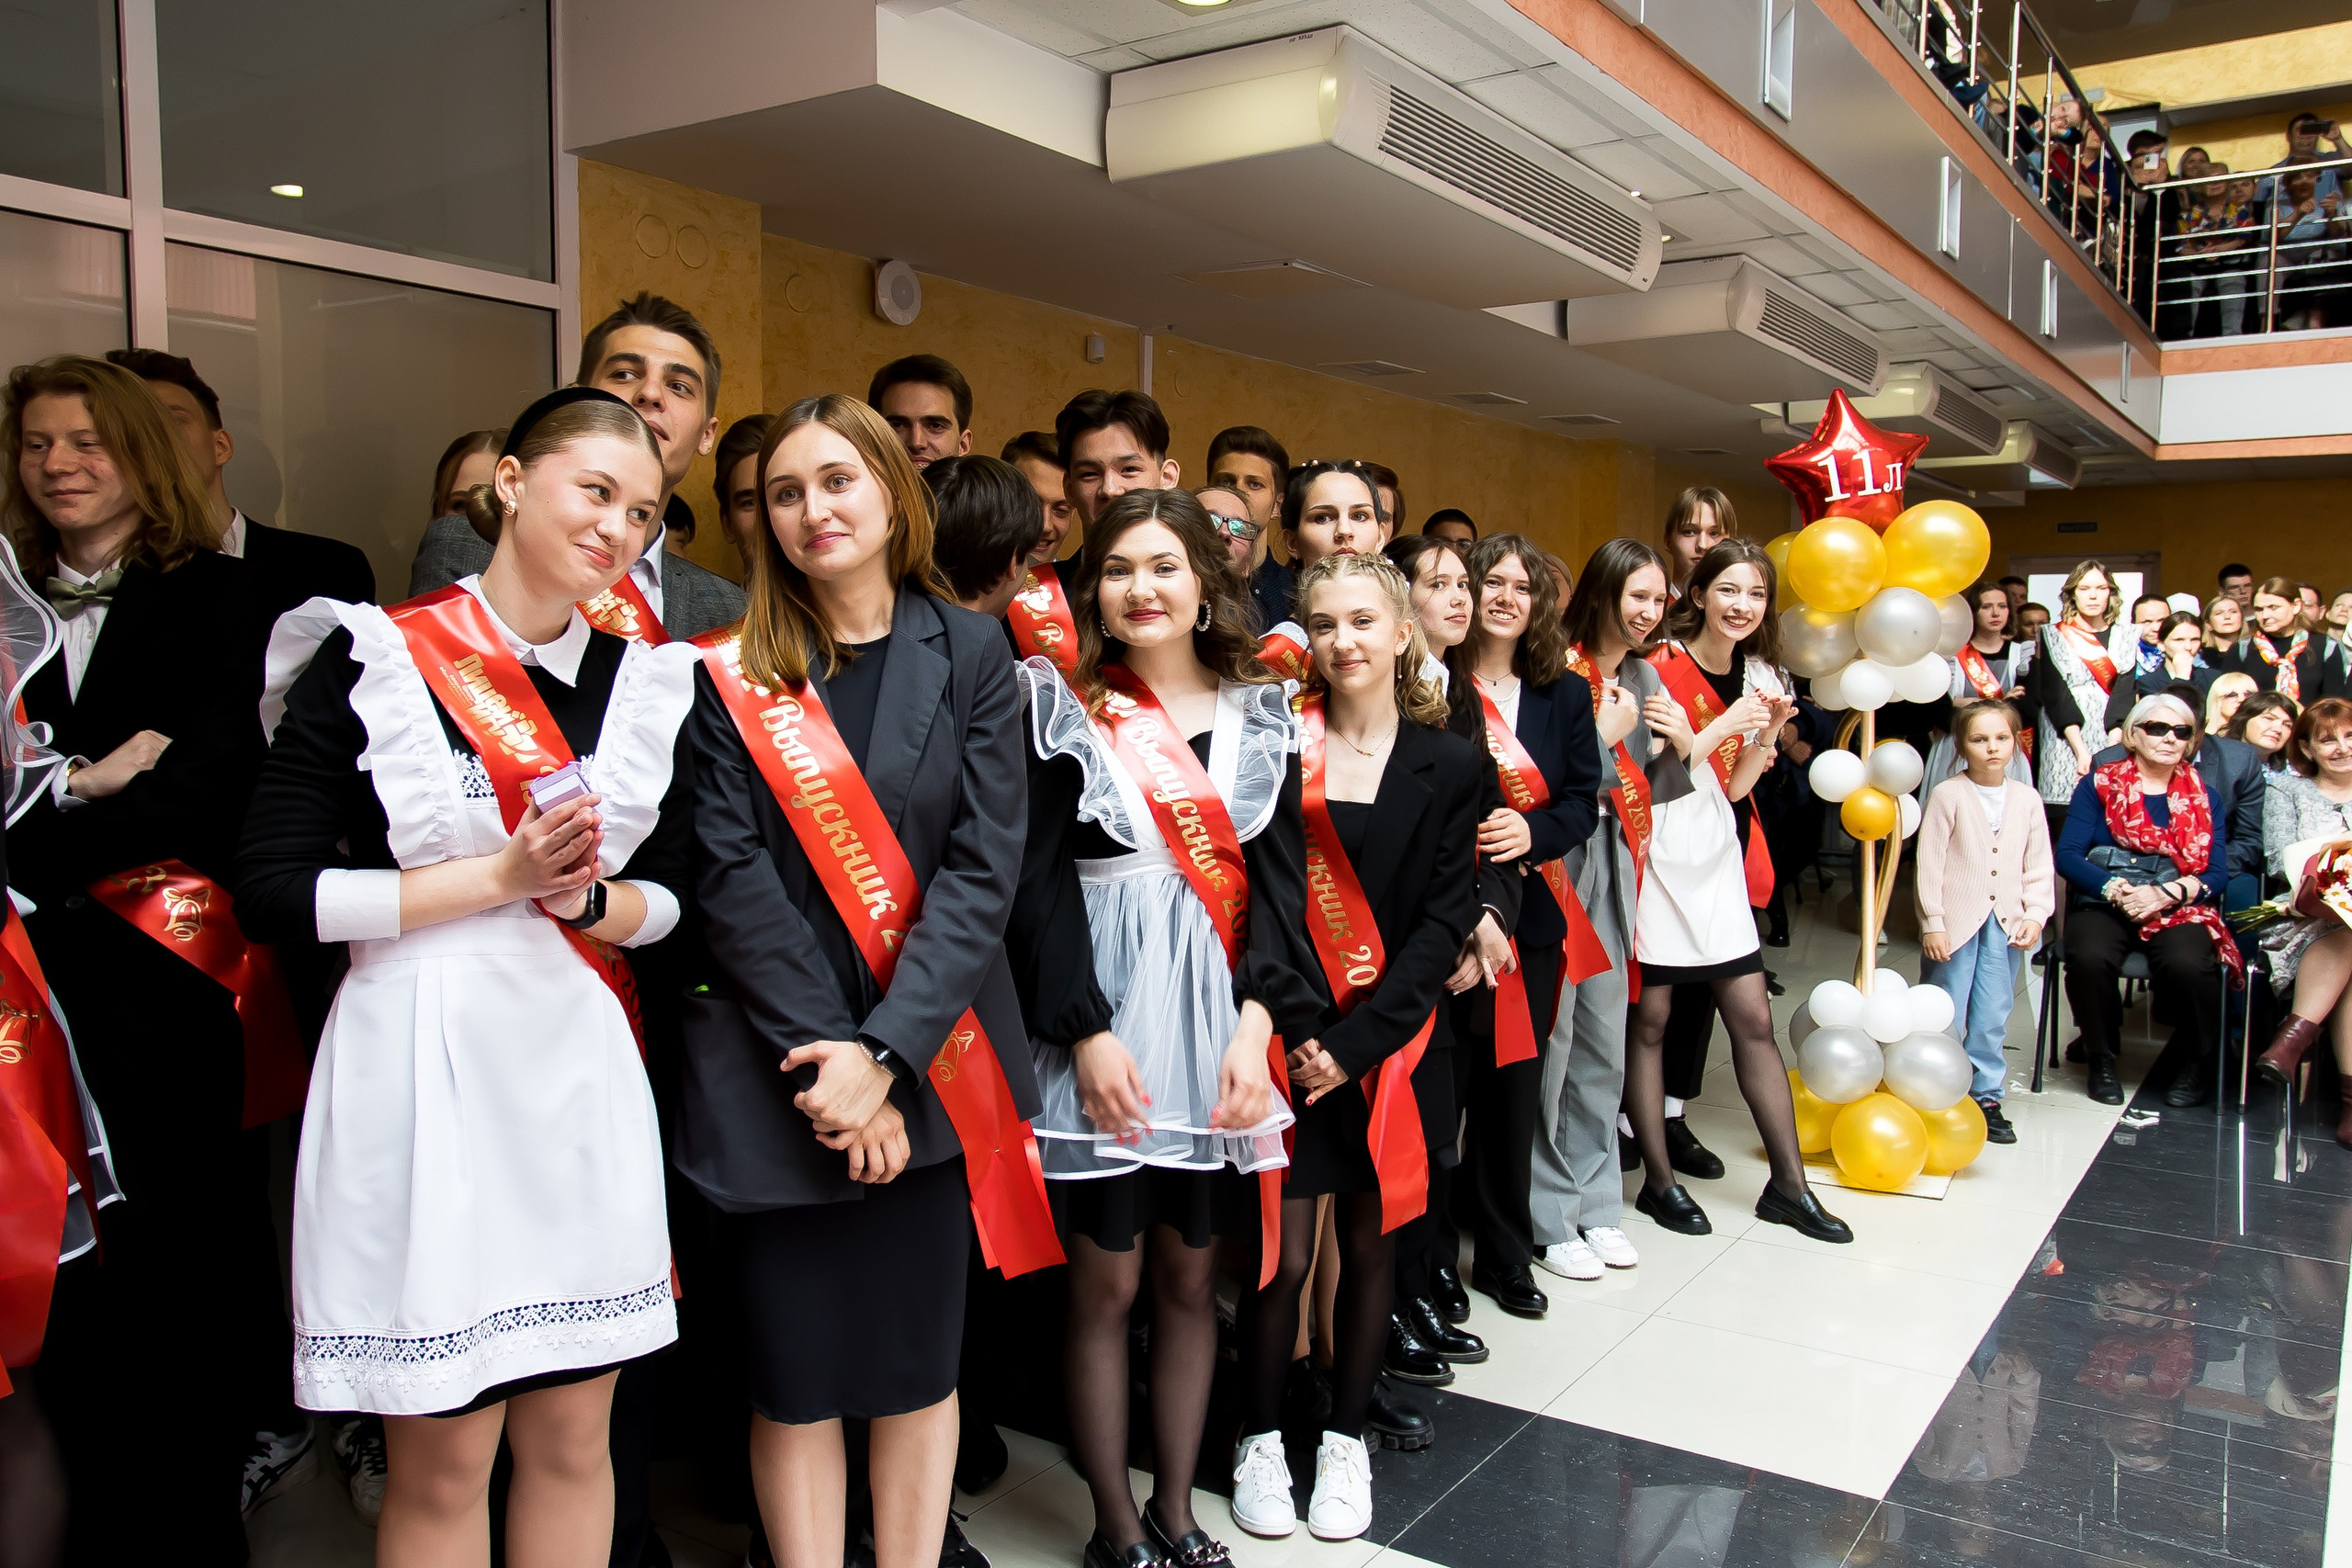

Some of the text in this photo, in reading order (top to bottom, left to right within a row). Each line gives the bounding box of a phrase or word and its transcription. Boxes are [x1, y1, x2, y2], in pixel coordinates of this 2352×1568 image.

[452, 652, 526, 727] Лицей
[758, 694, 899, 920] Выпускник
[1122, 715, 1229, 893] Выпускник
[1337, 943, 1378, 987] 20
